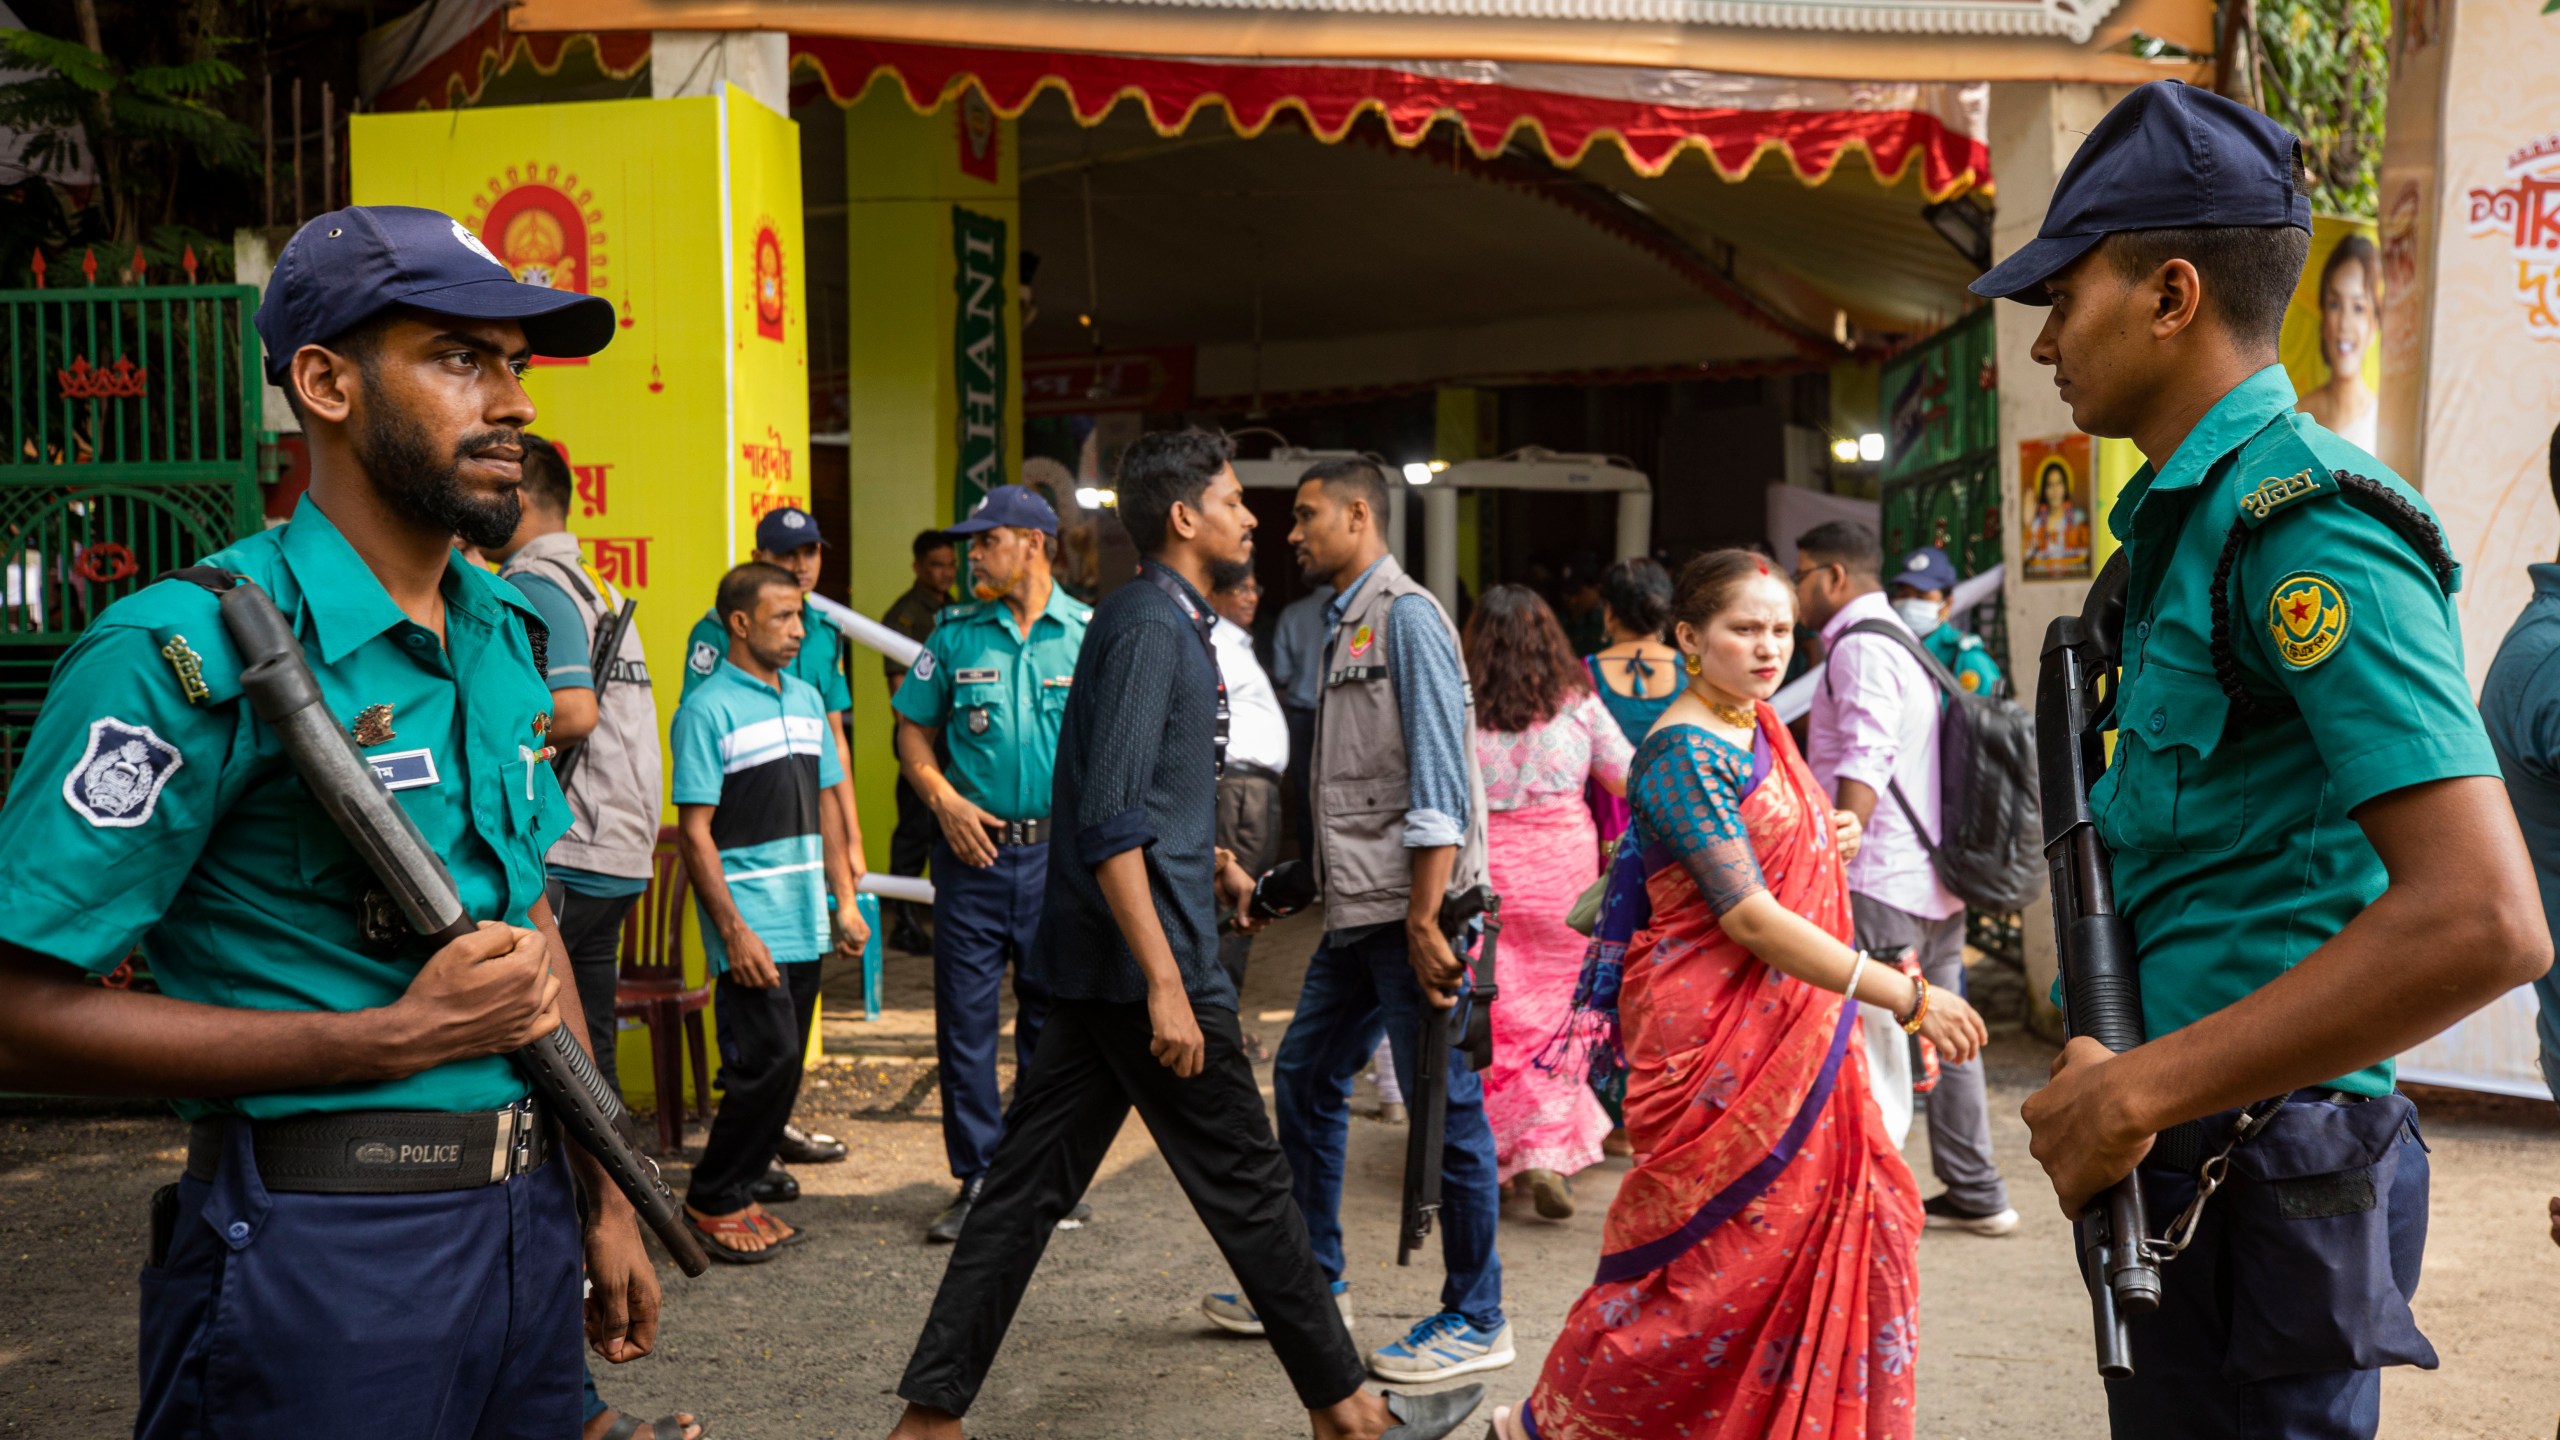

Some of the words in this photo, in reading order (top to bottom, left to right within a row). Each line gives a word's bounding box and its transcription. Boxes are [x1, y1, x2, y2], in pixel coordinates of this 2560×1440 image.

[742, 424, 792, 482] শারদীয়
[2240, 467, 2321, 519] পুলিশ
[399, 1144, 460, 1164] POLICE
